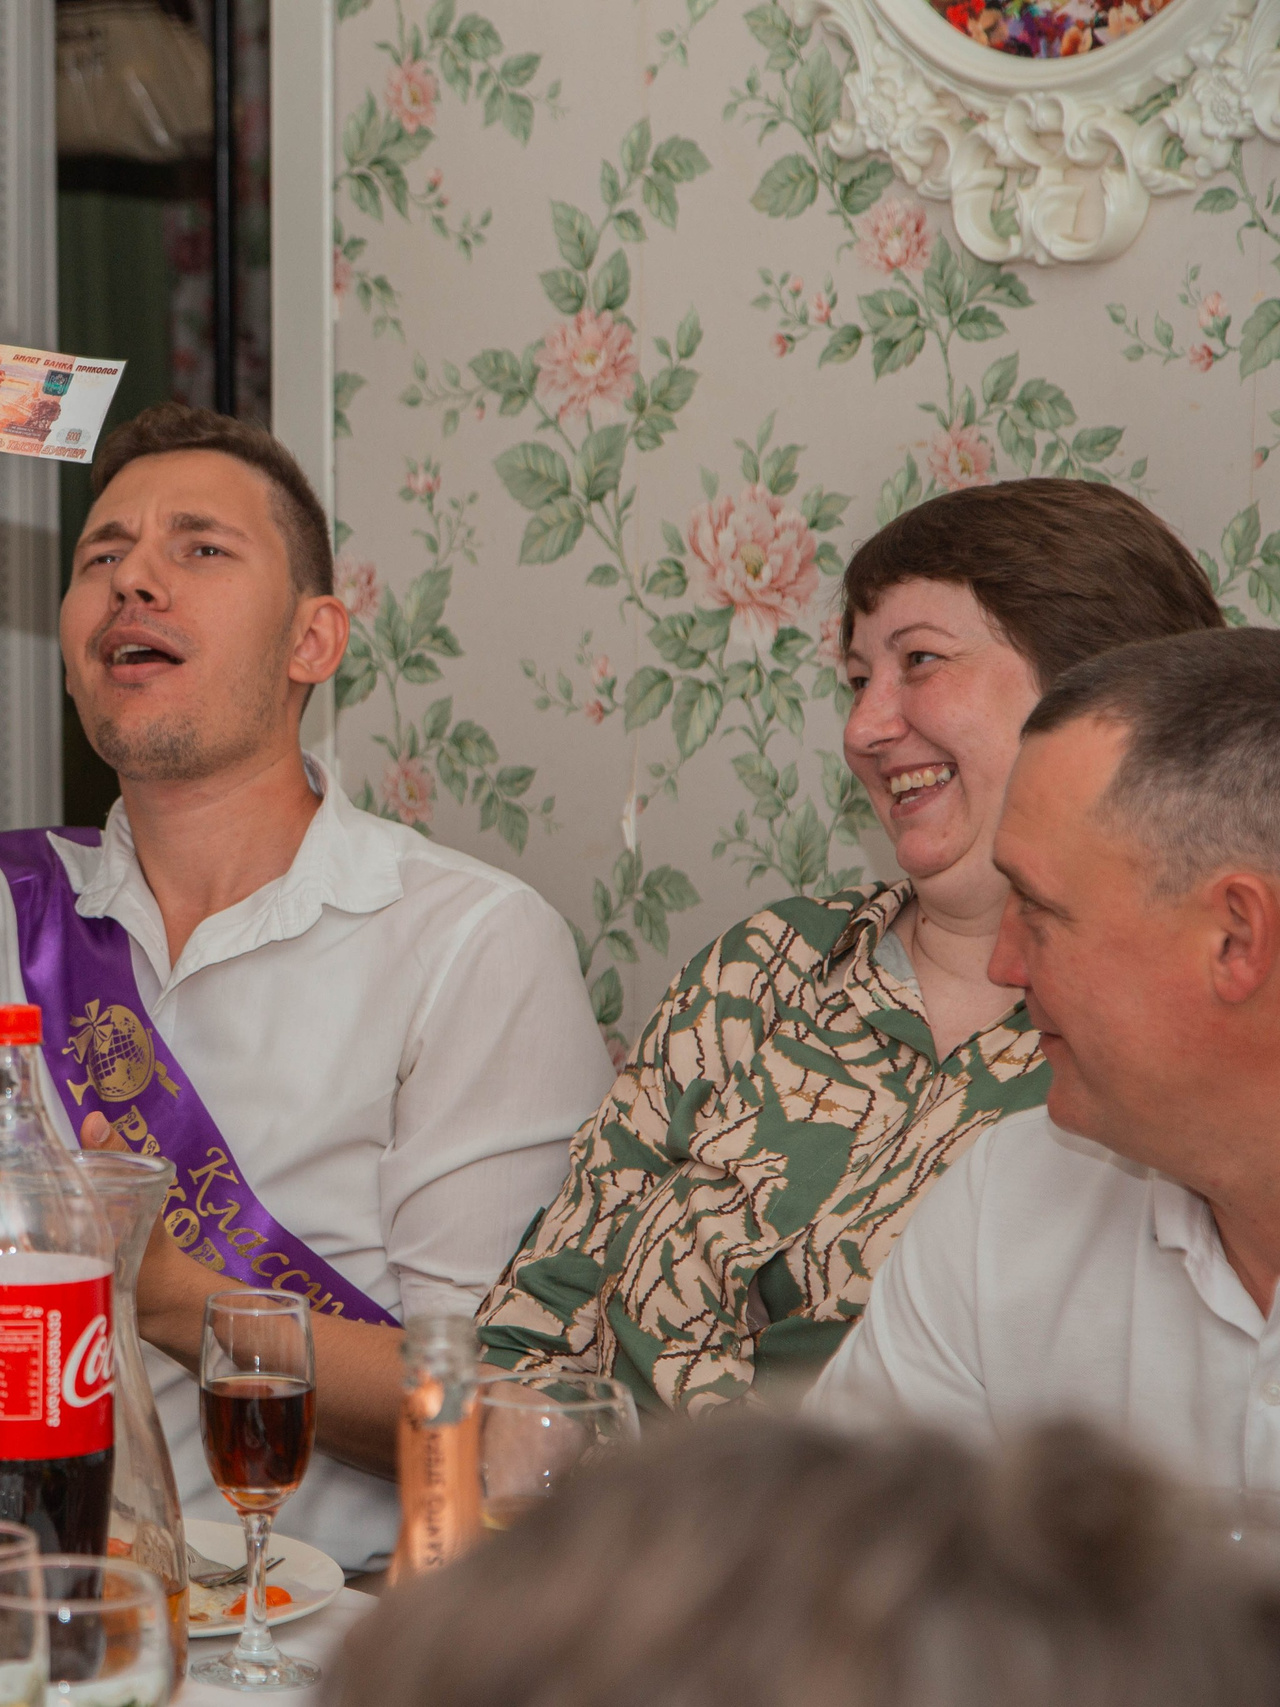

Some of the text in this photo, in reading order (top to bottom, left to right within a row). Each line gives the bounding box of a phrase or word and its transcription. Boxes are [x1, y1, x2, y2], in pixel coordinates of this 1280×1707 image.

[13, 353, 118, 376] БИЛЕТ БАНКА ПРИКОЛОВ
